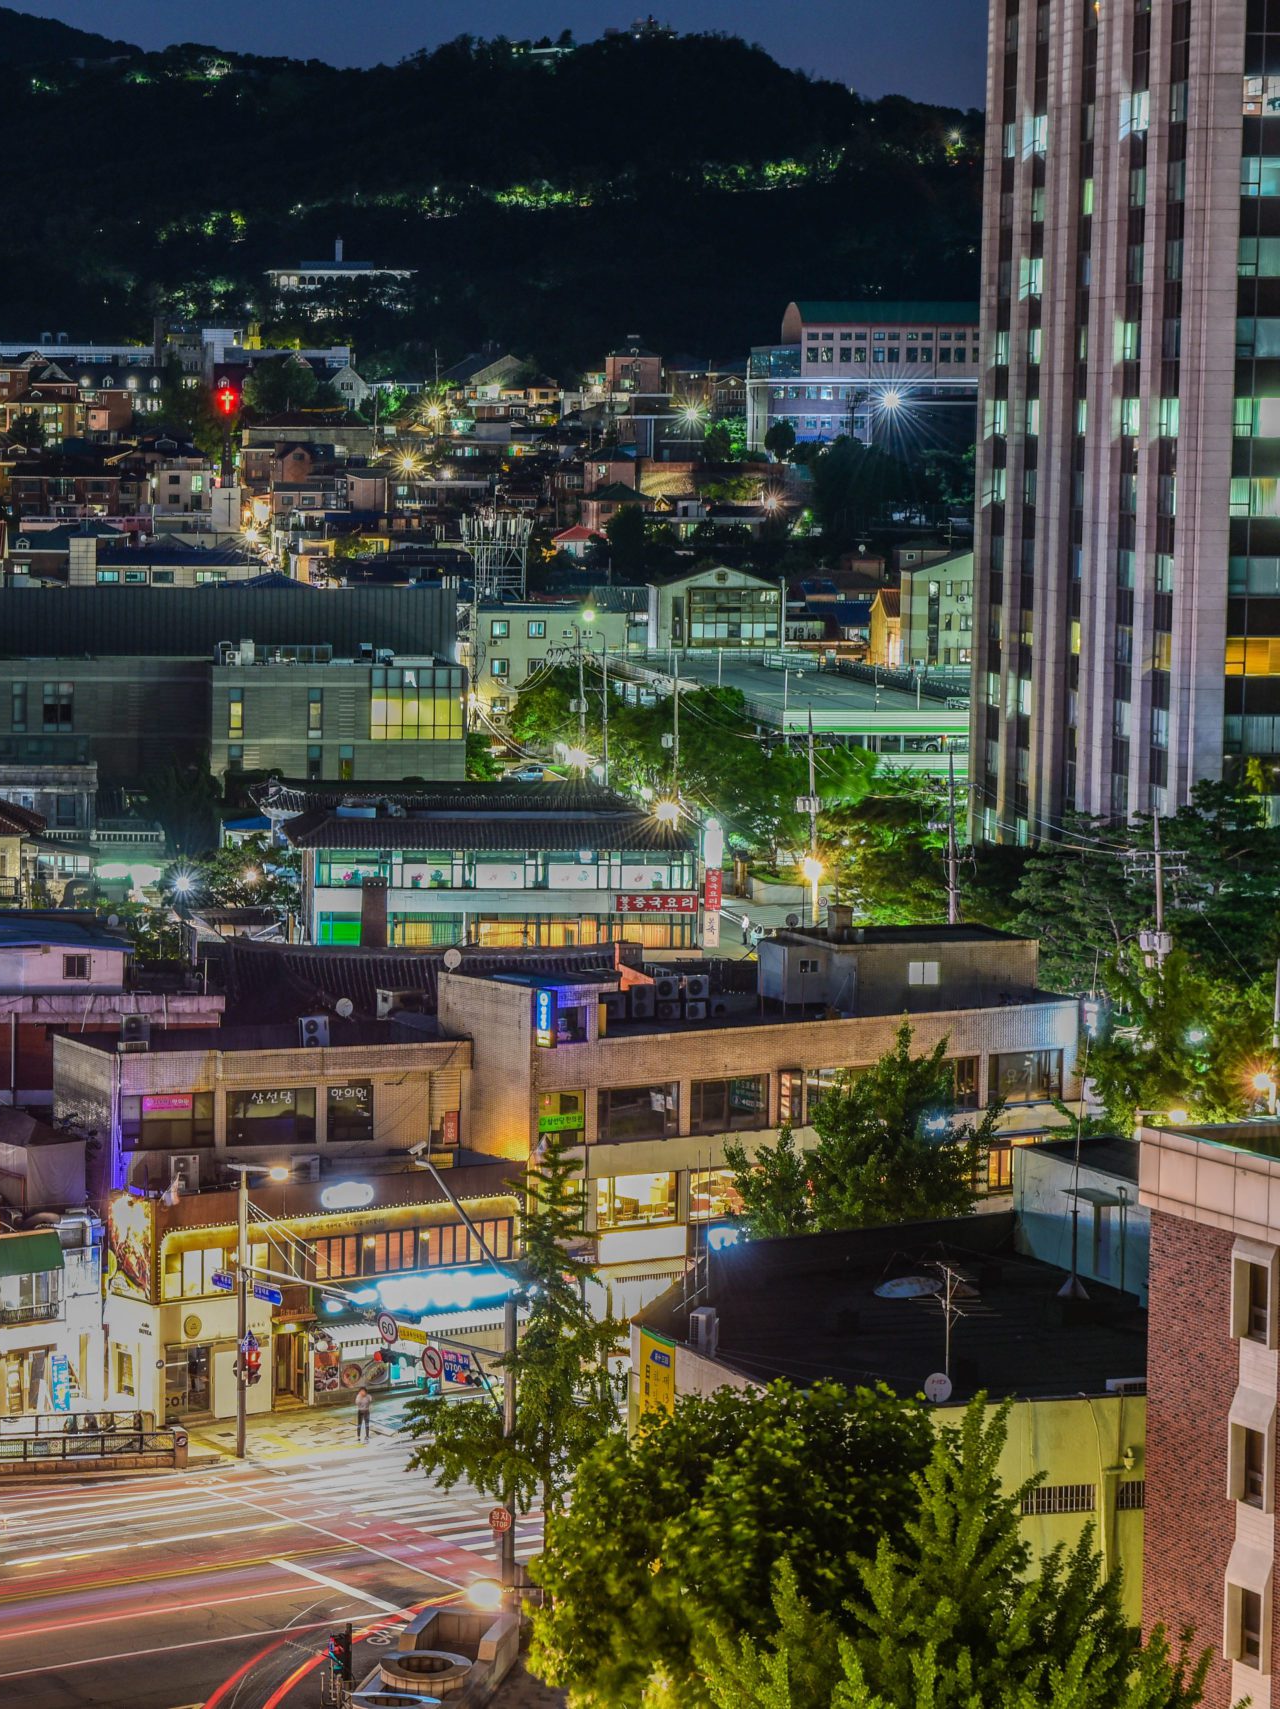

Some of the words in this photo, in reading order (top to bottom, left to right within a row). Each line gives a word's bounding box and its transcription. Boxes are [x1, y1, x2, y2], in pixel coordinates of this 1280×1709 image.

[633, 896, 694, 909] 중국요리
[251, 1091, 293, 1104] 삼선당
[331, 1088, 368, 1101] 한의원
[381, 1321, 394, 1336] 60
[492, 1510, 508, 1520] 정지
[491, 1519, 508, 1528] STOP
